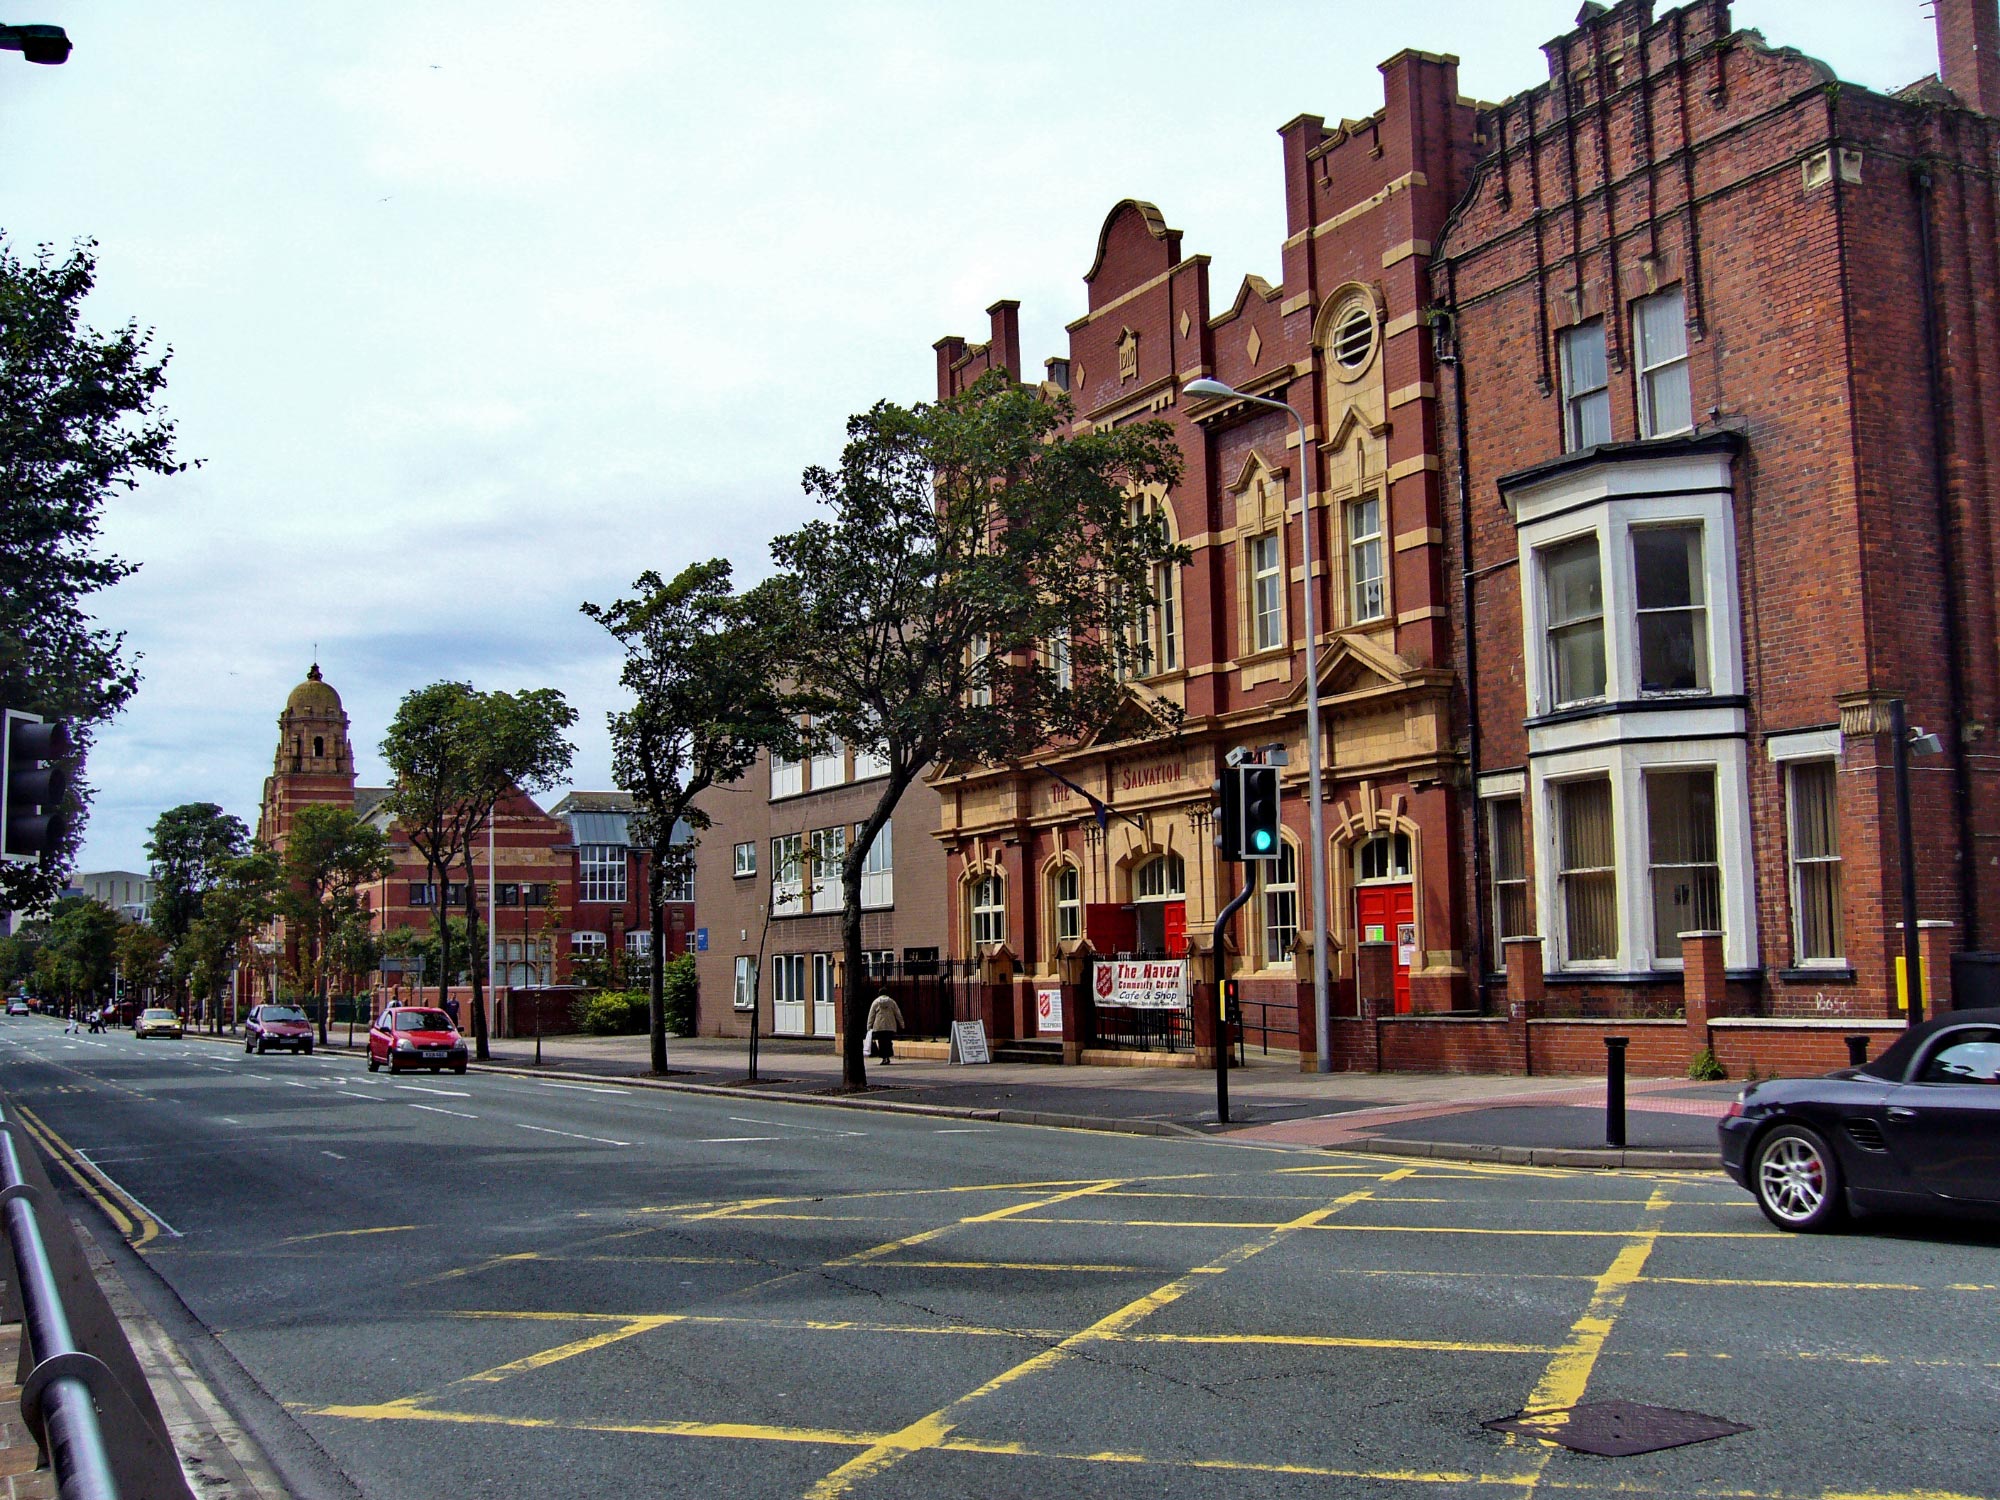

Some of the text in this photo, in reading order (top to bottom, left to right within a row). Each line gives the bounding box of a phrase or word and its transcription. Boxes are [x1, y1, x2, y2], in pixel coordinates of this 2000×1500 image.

[1120, 347, 1135, 370] 1910
[1122, 763, 1181, 790] SALVATION
[1118, 963, 1180, 979] The Haven
[1118, 980, 1179, 990] Community Centre
[1119, 991, 1177, 1001] Cafe & Shop
